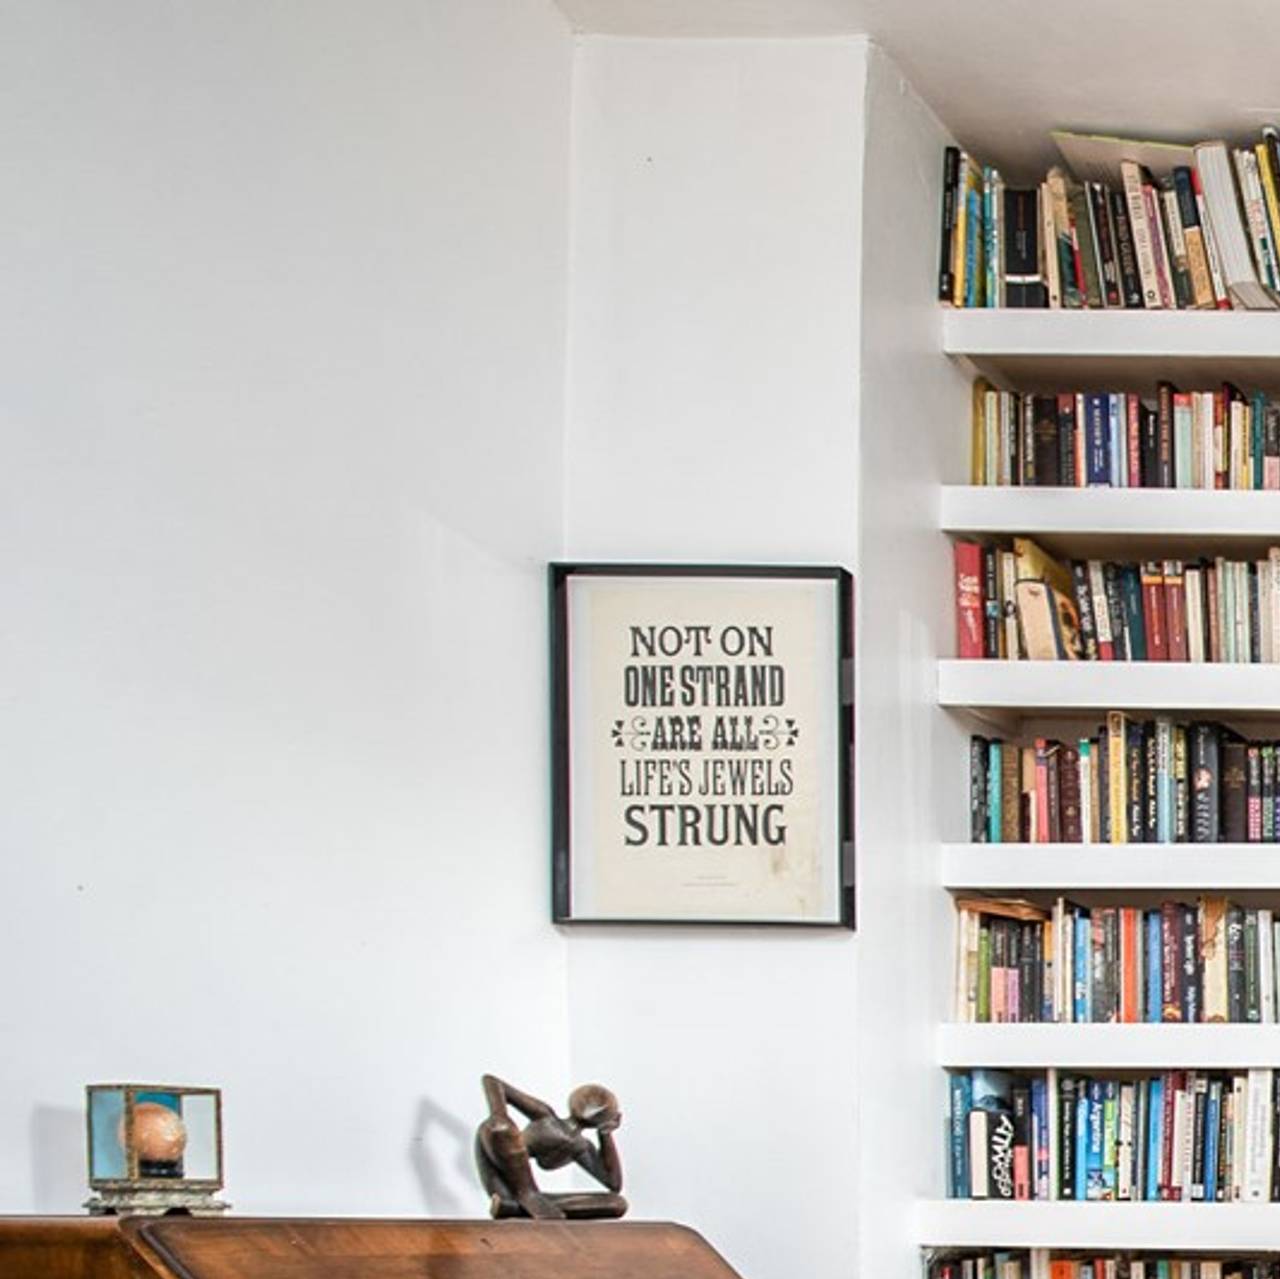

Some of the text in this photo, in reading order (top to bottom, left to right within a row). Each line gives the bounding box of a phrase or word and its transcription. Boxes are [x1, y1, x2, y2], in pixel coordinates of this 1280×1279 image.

[629, 626, 774, 657] NOT ON
[623, 665, 785, 707] ONE STRAND
[650, 715, 760, 751] ARE ALL
[619, 759, 794, 797] LIFE'S JEWELS
[623, 803, 787, 847] STRUNG
[1090, 1101, 1103, 1153] Argentina
